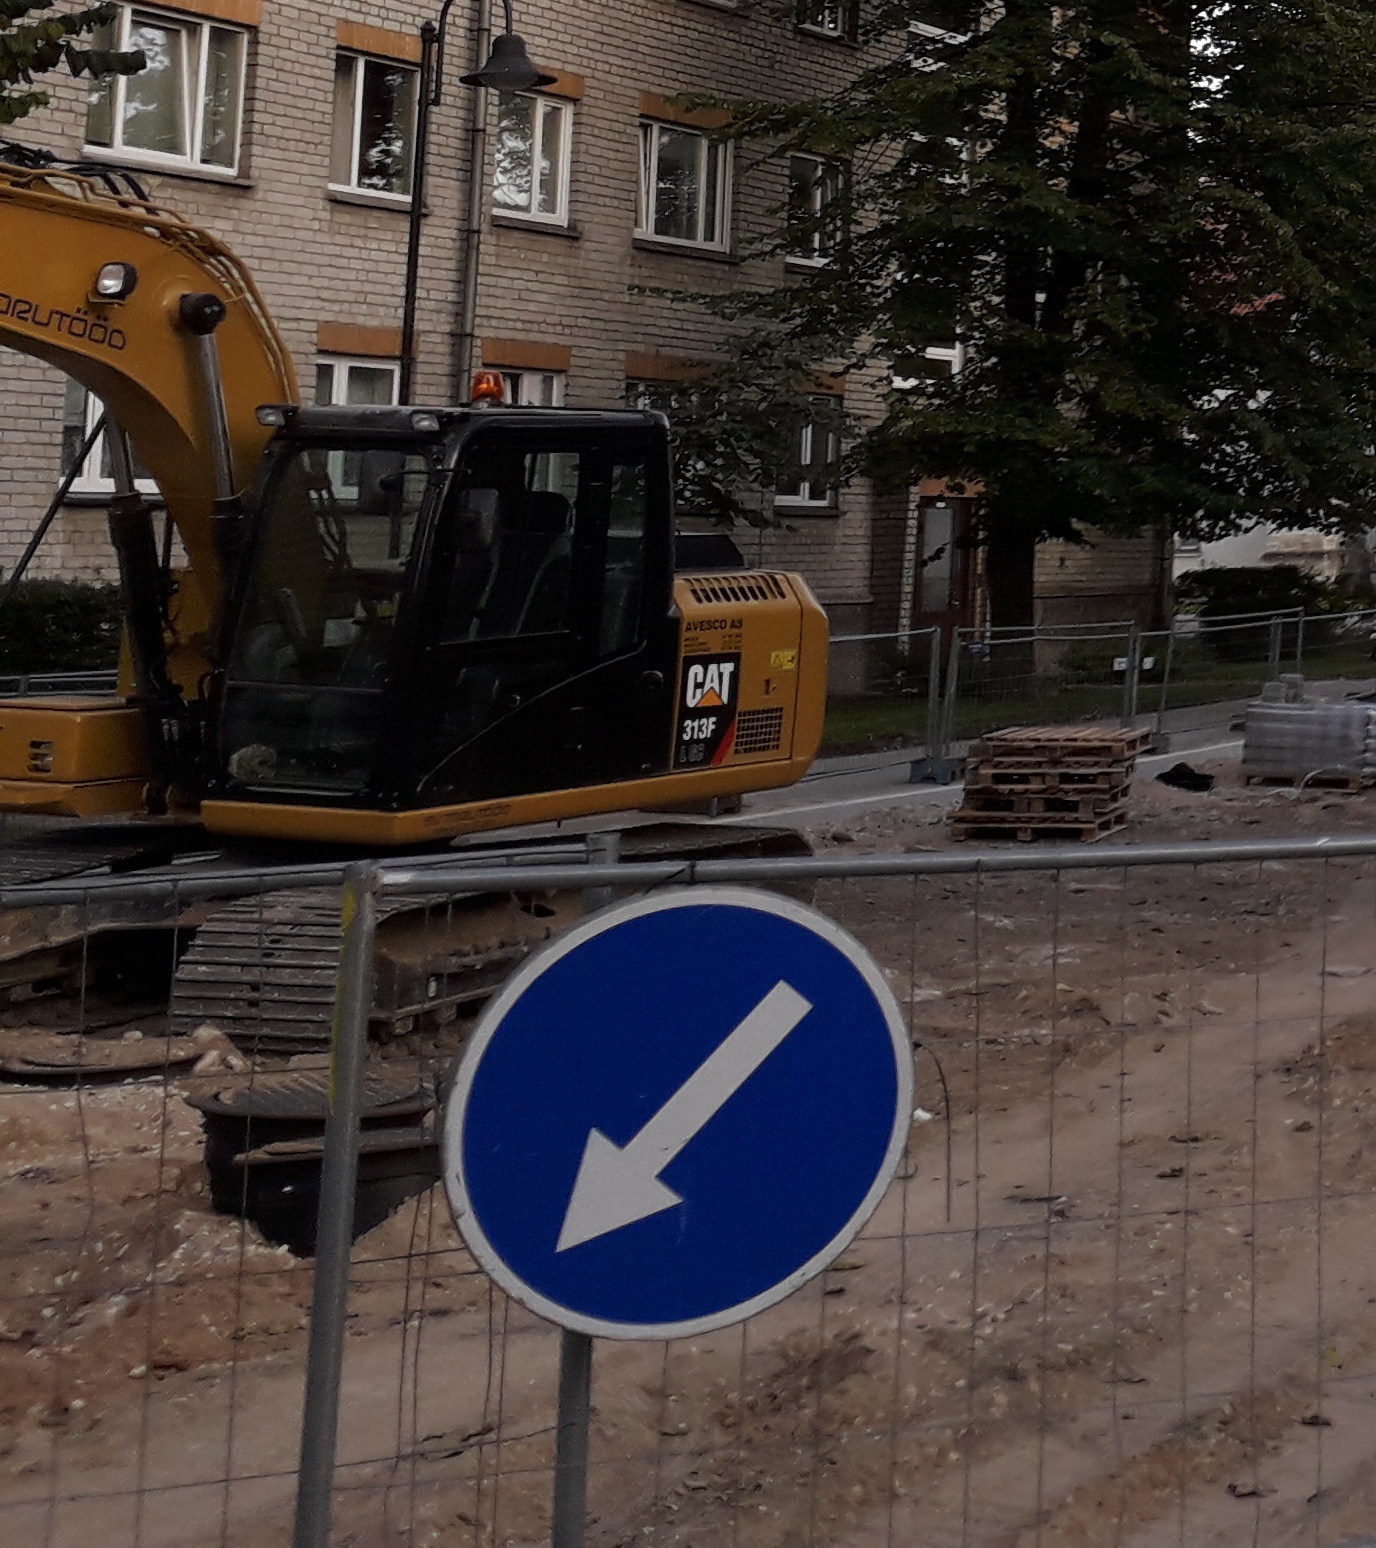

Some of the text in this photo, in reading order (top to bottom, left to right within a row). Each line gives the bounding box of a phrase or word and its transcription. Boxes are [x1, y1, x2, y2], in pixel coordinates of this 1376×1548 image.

[684, 619, 727, 632] AVESCO
[685, 662, 735, 708] CAT
[682, 716, 717, 741] 313F
